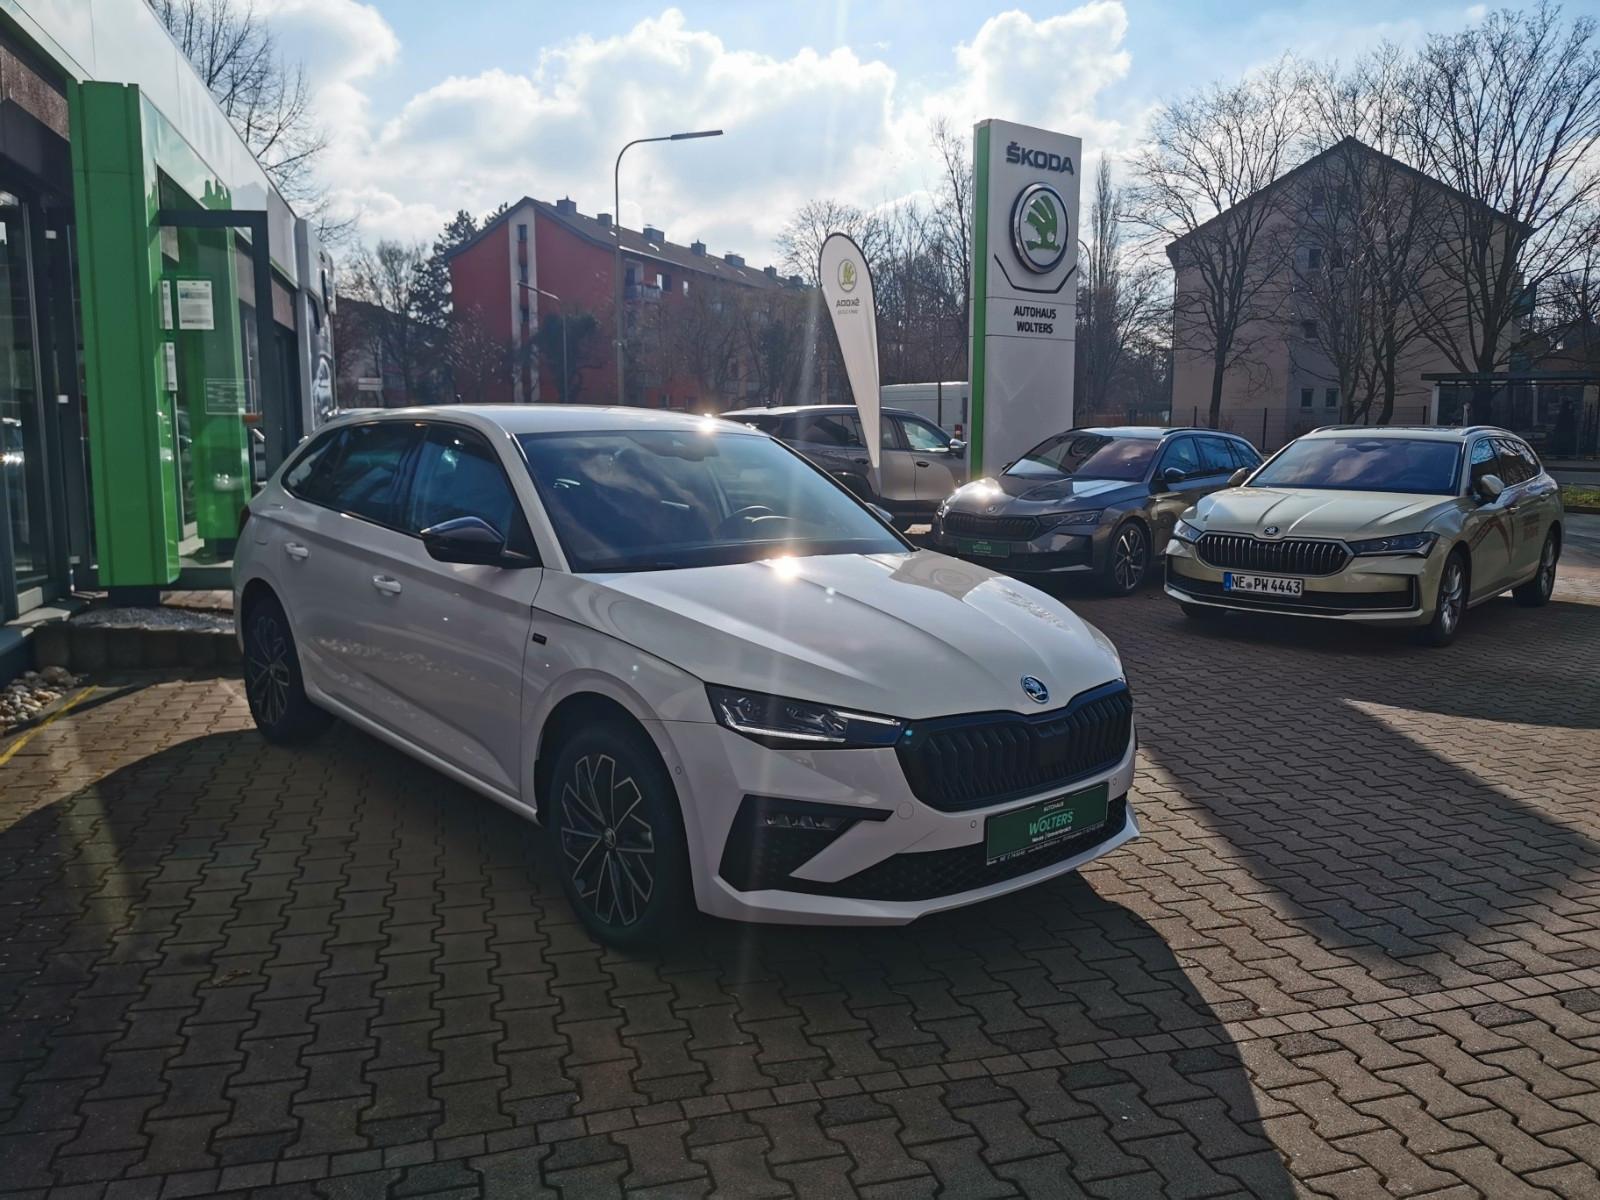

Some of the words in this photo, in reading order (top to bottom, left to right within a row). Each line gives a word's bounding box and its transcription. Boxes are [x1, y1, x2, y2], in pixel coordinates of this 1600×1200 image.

[1006, 141, 1075, 176] ŠKODA
[1013, 305, 1057, 319] AUTOHAUS
[1016, 321, 1054, 334] WOLTERS
[1232, 575, 1246, 589] NE
[1253, 577, 1269, 591] PW
[1271, 580, 1301, 594] 4443
[1029, 810, 1074, 836] WOLTERS
